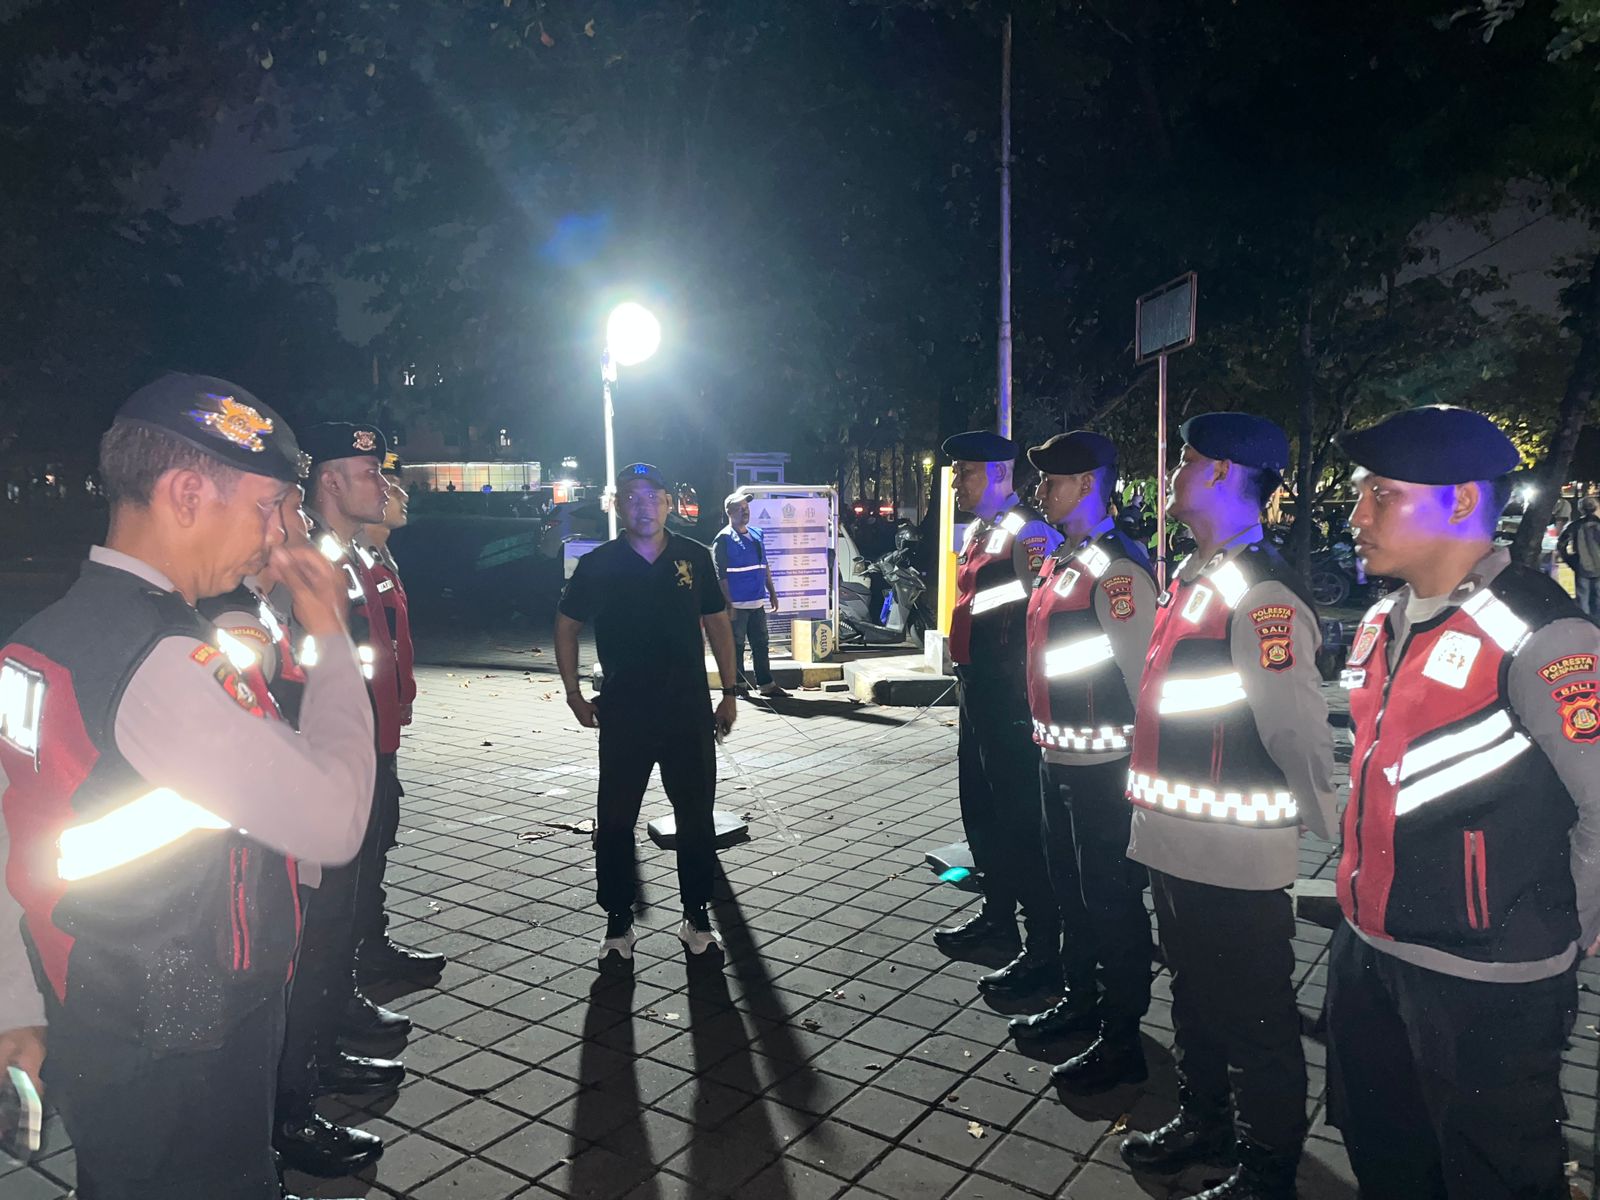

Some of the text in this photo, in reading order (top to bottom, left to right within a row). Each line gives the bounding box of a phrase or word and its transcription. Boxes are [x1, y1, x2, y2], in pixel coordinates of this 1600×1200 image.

[1252, 608, 1291, 619] POLRESTA
[1262, 626, 1287, 634] BALI
[820, 628, 828, 653] AQUA
[1542, 657, 1593, 678] POLRESTA
[1550, 664, 1589, 679] DENPASAR
[1561, 683, 1590, 696] BALI
